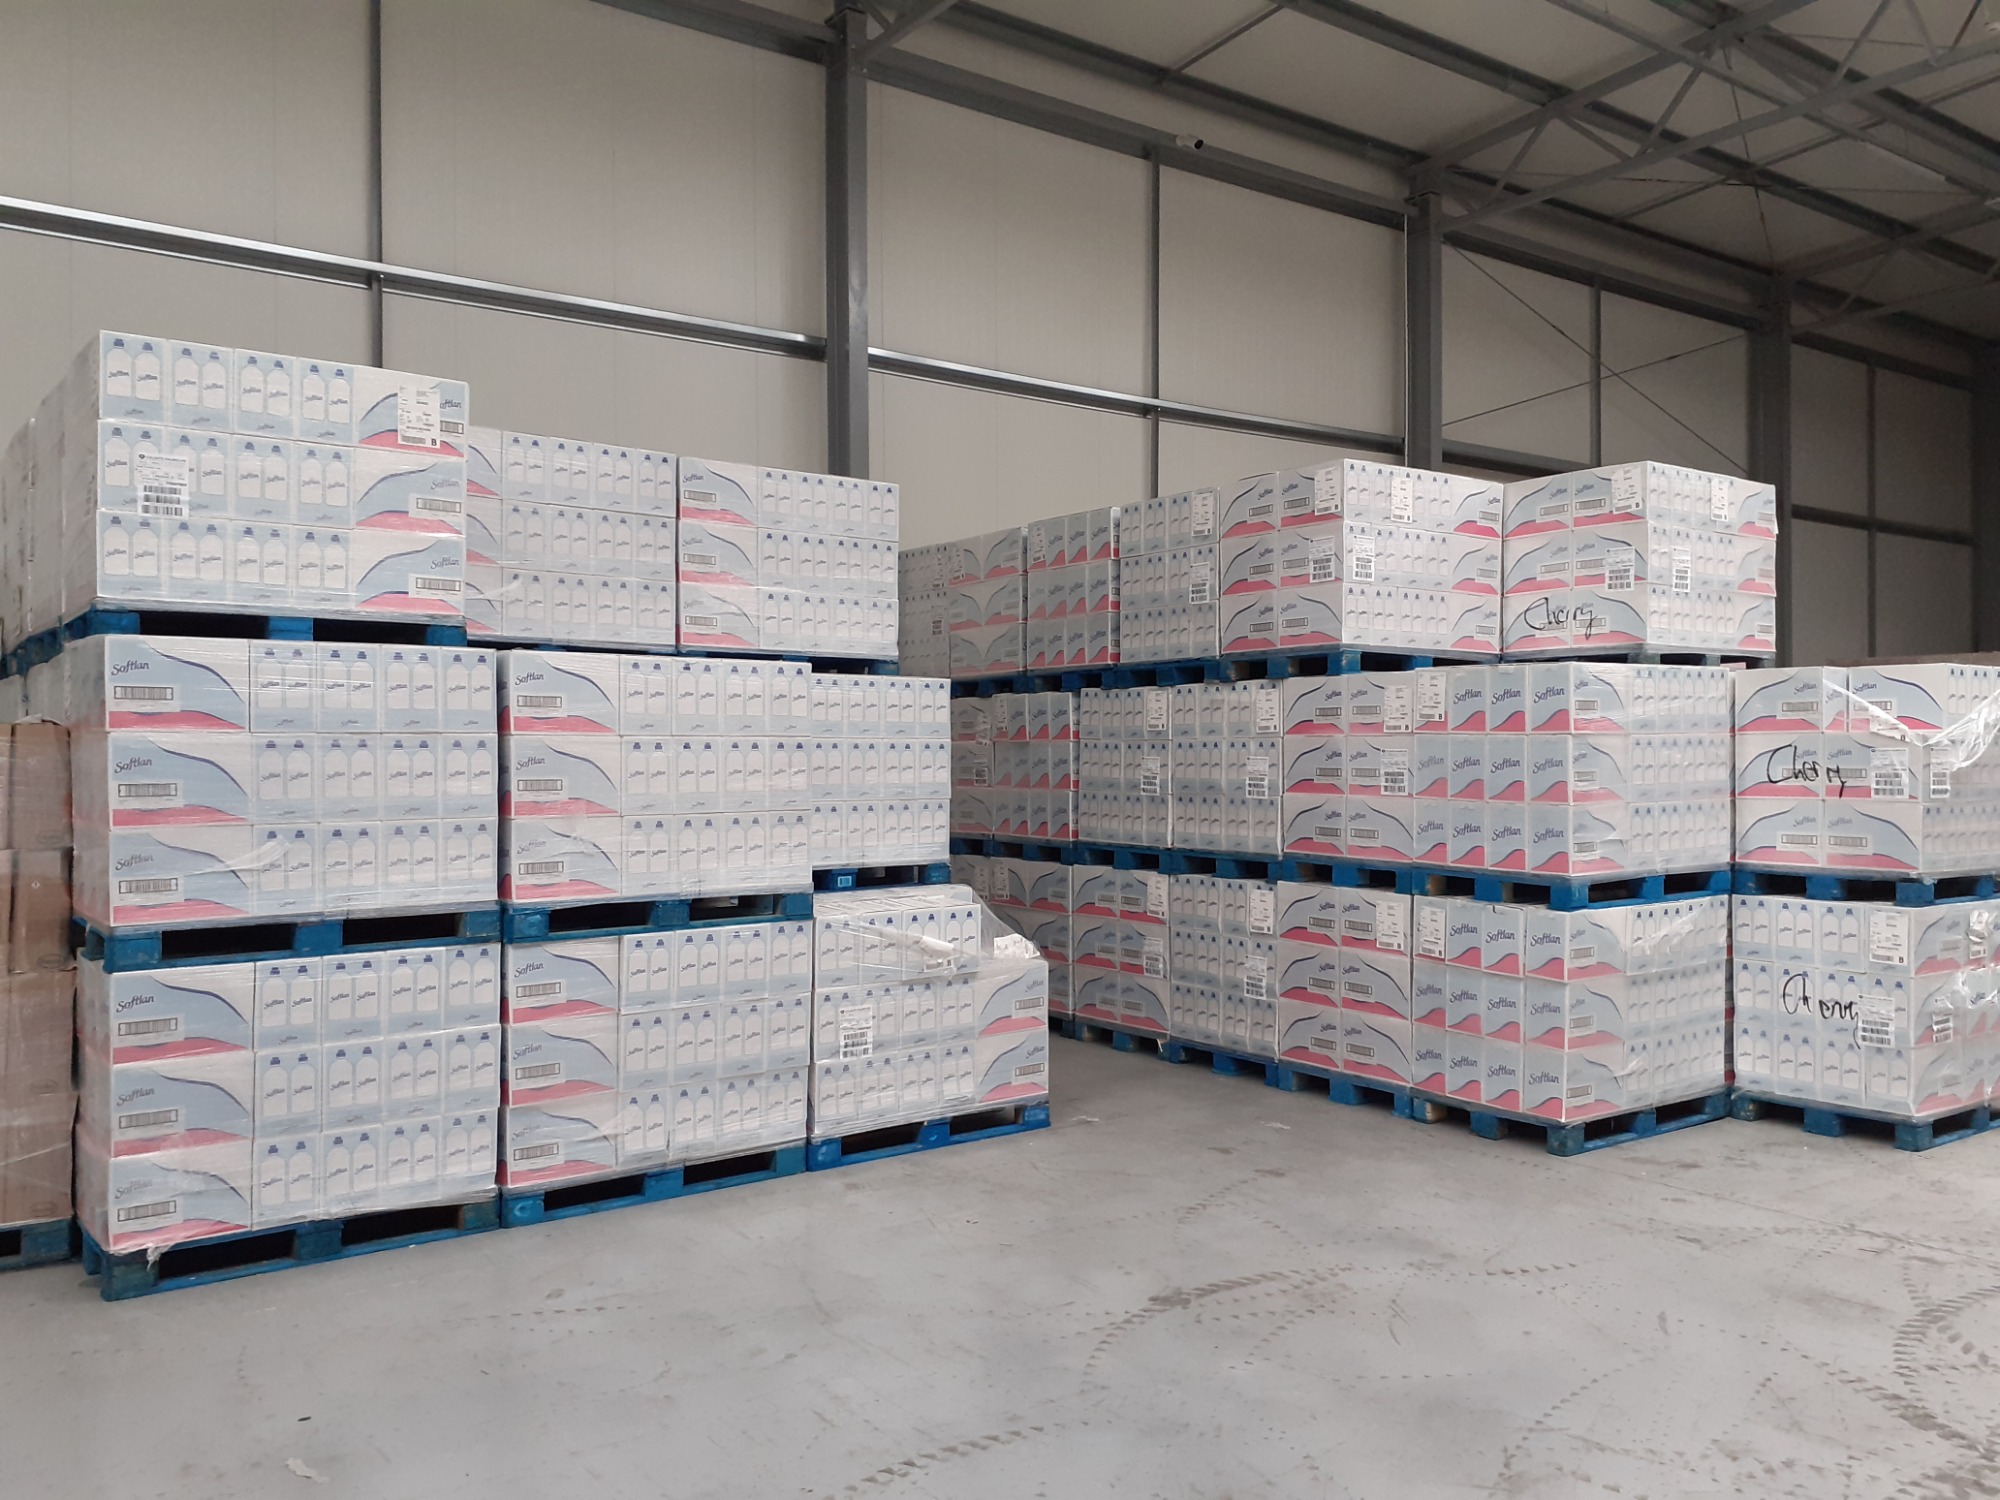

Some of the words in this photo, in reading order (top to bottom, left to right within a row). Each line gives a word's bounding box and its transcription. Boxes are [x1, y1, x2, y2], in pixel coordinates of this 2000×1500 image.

[440, 399, 462, 409] oftlan
[111, 660, 149, 676] Softlan
[515, 672, 544, 685] Softlan
[1453, 688, 1482, 704] Softlan
[1492, 688, 1521, 704] Softlan
[1534, 686, 1565, 703] Softlan
[1794, 683, 1817, 695] Softlan
[1853, 683, 1877, 695] Softlan
[1827, 749, 1852, 760] Softlan
[114, 757, 152, 773] Softlan
[516, 757, 545, 770] Softlan
[1417, 755, 1444, 771] Softlan
[1452, 756, 1481, 772] Softlan
[1490, 756, 1520, 773] Softlan
[1533, 757, 1563, 774] Softlan
[1417, 820, 1444, 835] Softlan
[1453, 822, 1481, 838] Softlan
[1492, 825, 1521, 841] Softlan
[1533, 826, 1564, 843] Softlan
[115, 854, 154, 871] Softlan
[1450, 923, 1478, 937] Softlan
[1485, 929, 1515, 944] Softlan
[1530, 932, 1561, 947] Softlan
[514, 962, 544, 978] Softlan
[1416, 984, 1443, 997] Softlan
[1450, 989, 1478, 1004] Softlan
[116, 995, 154, 1013] Softlan
[1487, 997, 1517, 1011] Softlan
[1530, 1001, 1561, 1016] Softlan
[513, 1044, 542, 1060] Softlan
[1416, 1049, 1442, 1061] Softlan
[1450, 1056, 1478, 1070] Softlan
[1487, 1064, 1516, 1078] Softlan
[1529, 1069, 1560, 1085] Softlan
[117, 1088, 155, 1106] Softlan
